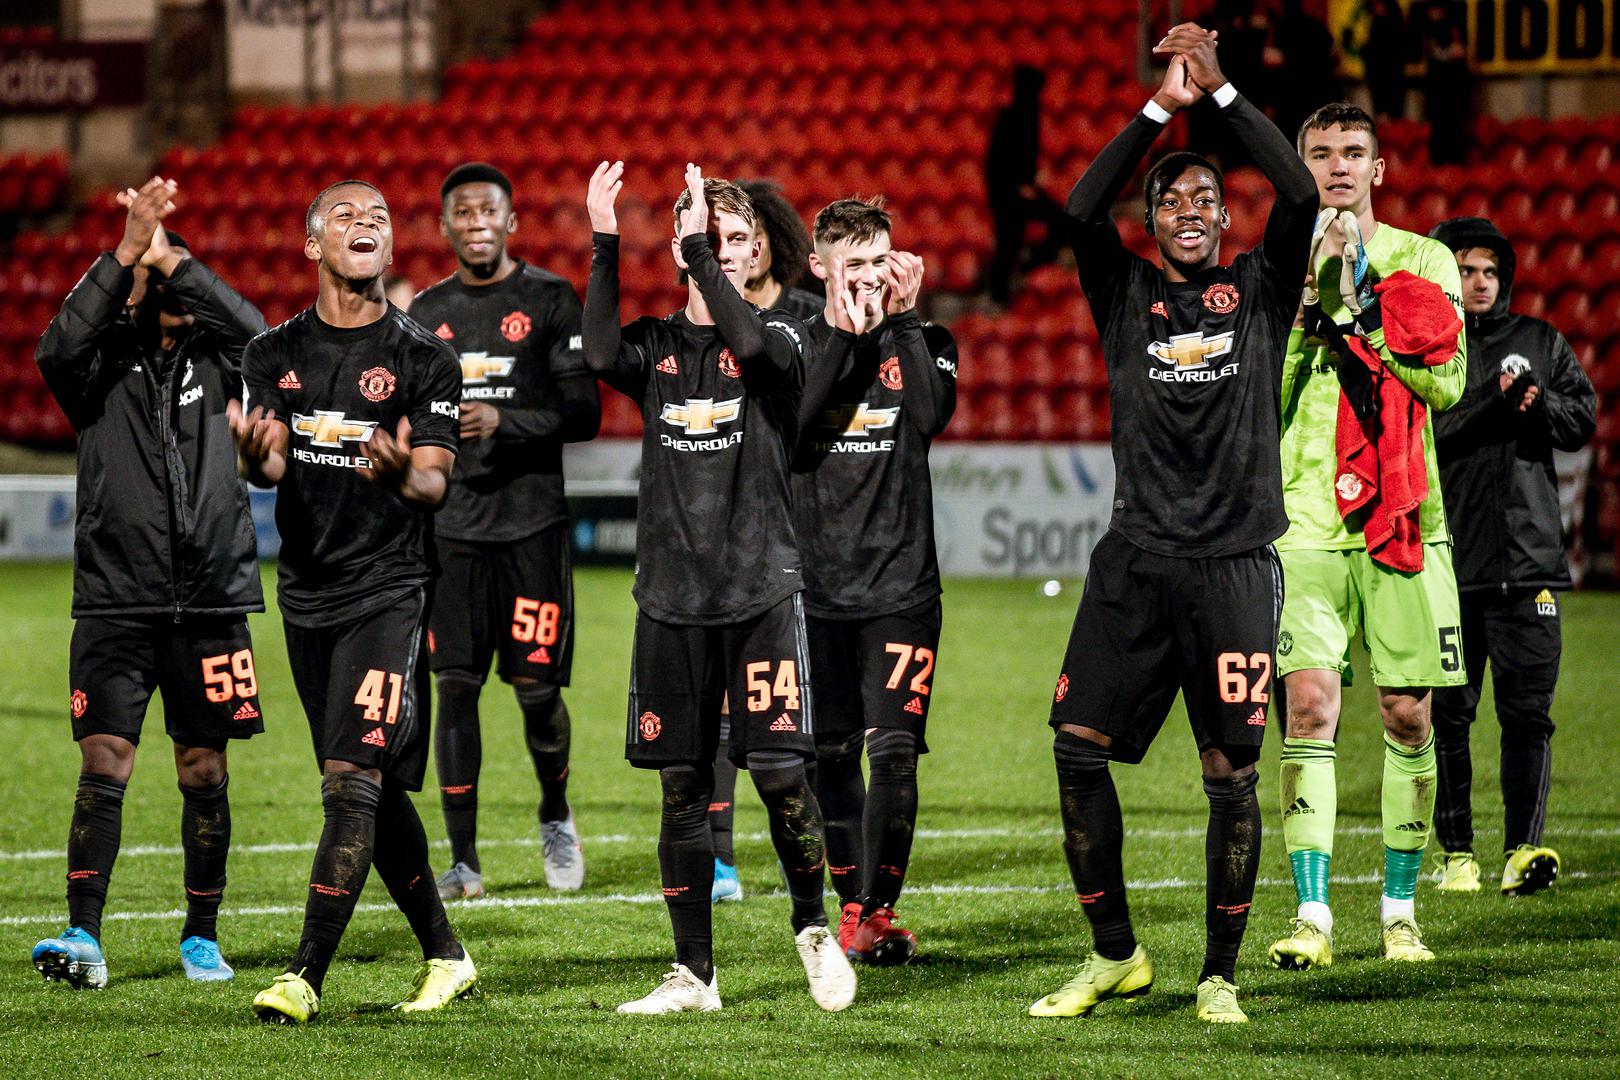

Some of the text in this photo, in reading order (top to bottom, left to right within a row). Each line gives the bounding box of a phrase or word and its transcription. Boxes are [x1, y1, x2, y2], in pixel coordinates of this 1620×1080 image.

[511, 596, 560, 646] 58
[1537, 602, 1557, 617] U23
[201, 648, 258, 703] 59
[746, 660, 800, 713] 54
[885, 642, 933, 696] 72
[1217, 652, 1271, 704] 62
[233, 711, 259, 721] adidas
[354, 668, 403, 725] 41
[361, 736, 386, 748] adidas
[770, 724, 797, 732] adidas
